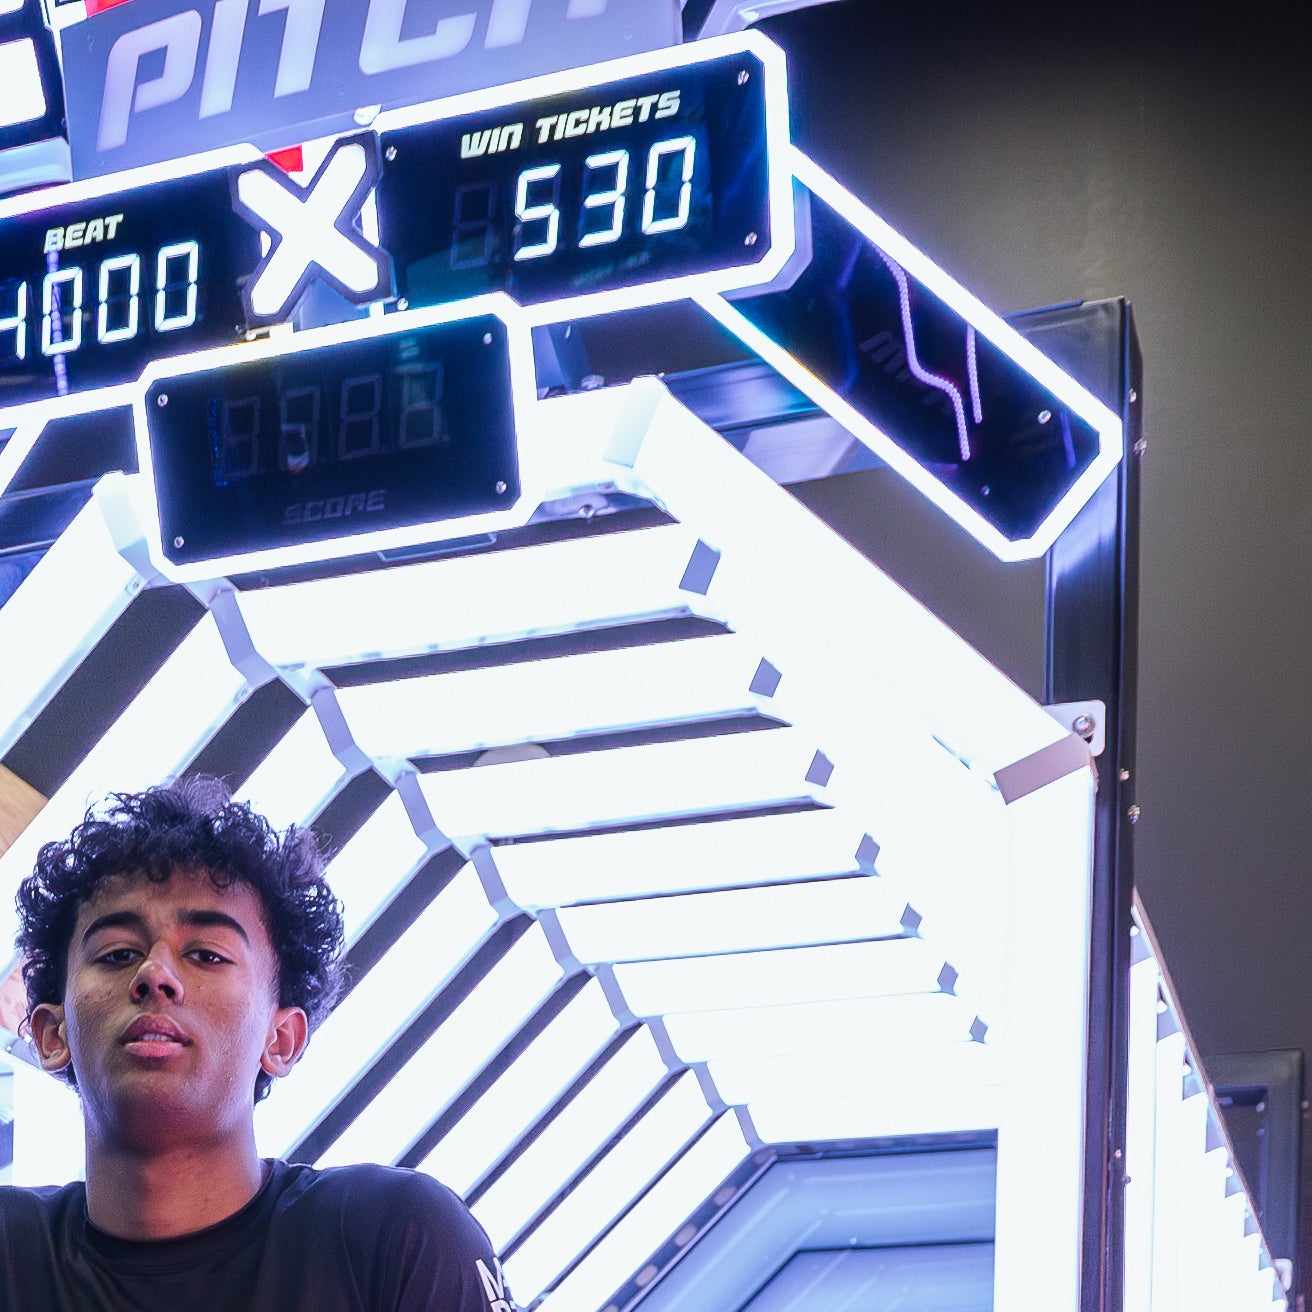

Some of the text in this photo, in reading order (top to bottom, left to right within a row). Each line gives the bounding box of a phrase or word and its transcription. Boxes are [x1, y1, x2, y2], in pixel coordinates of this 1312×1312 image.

[461, 90, 681, 158] WIN TICKETS
[513, 136, 696, 261] 530
[44, 213, 123, 253] BEAT
